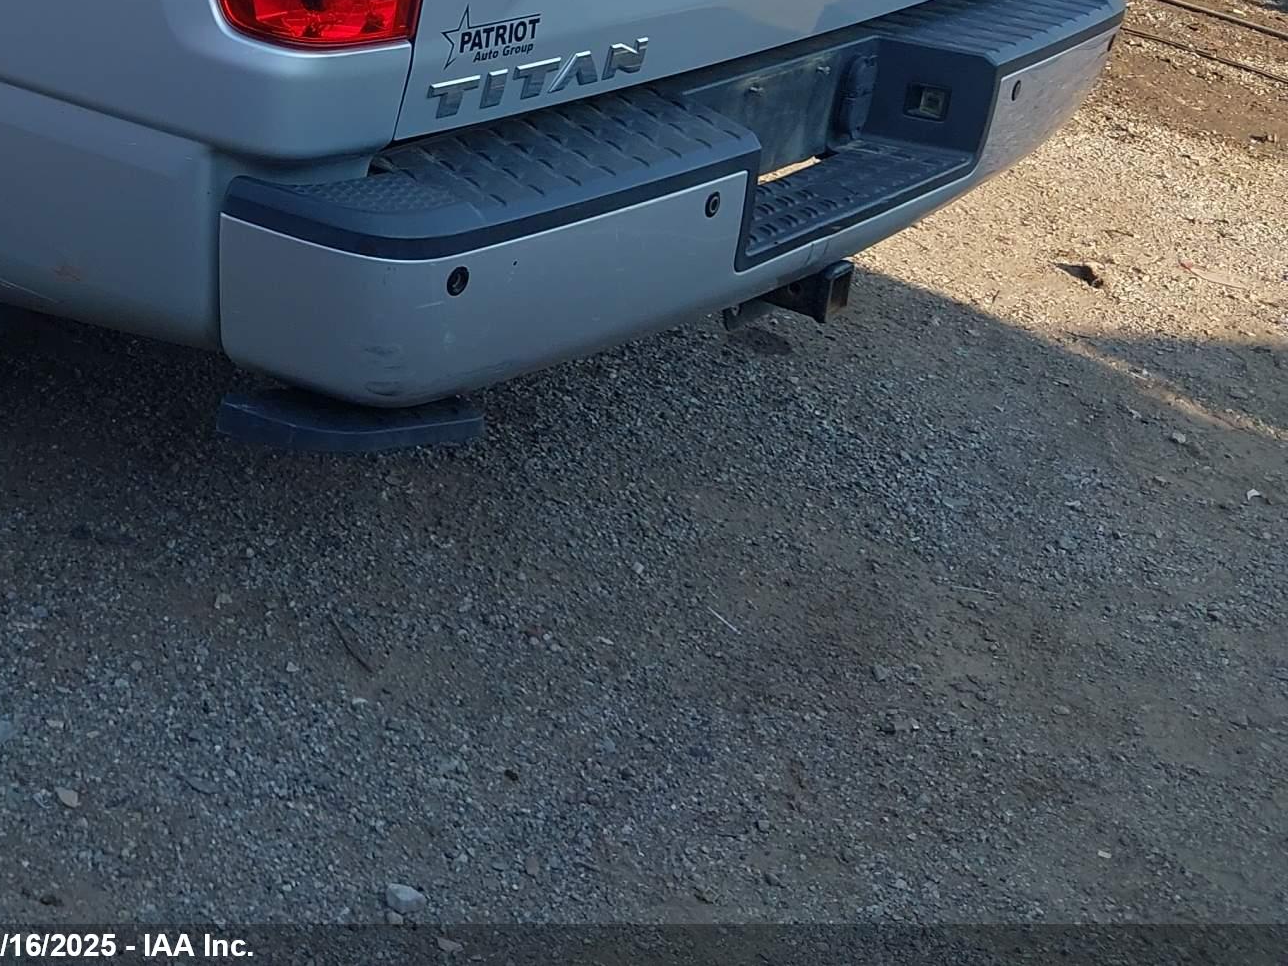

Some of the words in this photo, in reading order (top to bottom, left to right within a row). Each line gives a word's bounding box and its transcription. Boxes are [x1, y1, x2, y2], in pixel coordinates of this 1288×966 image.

[459, 18, 541, 53] PATRIOT
[473, 50, 499, 63] Auto
[502, 42, 534, 57] Group
[427, 37, 649, 119] TITAN
